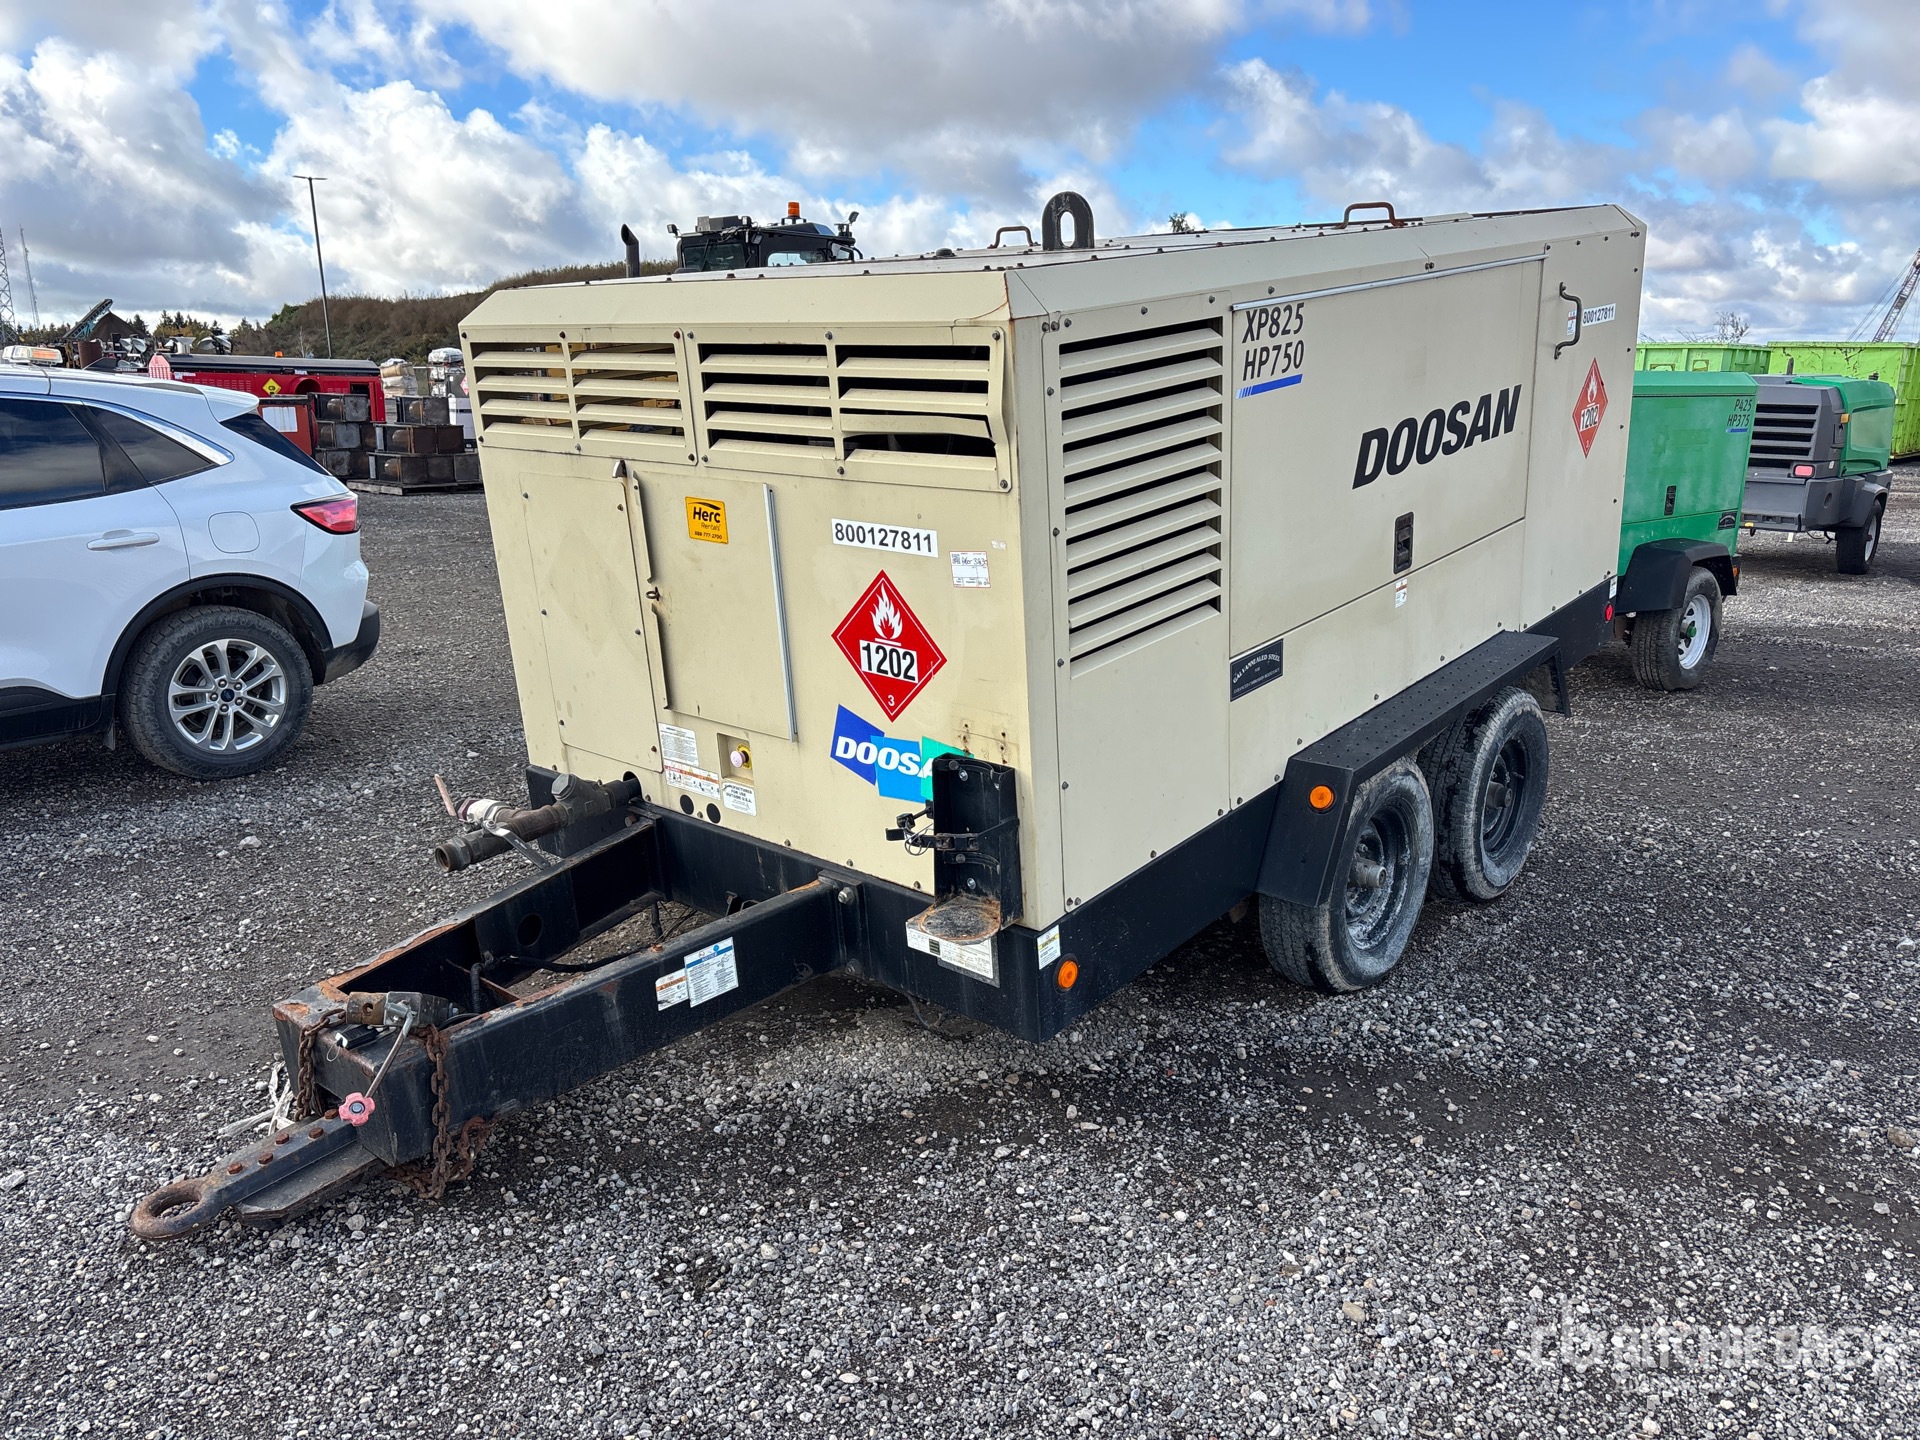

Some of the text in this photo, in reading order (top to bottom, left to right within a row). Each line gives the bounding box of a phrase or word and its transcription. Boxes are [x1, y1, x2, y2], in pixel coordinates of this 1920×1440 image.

[1241, 302, 1304, 344] XP825
[1242, 340, 1305, 382] HP750
[1581, 405, 1599, 430] 1202
[1726, 414, 1751, 427] HP375
[1733, 398, 1752, 412] P425
[1352, 384, 1522, 490] DOOSAN
[692, 506, 721, 524] Herc
[835, 522, 932, 553] 800127811
[861, 643, 917, 682] 1202
[887, 694, 895, 707] 3
[835, 735, 933, 779] DOOSA
